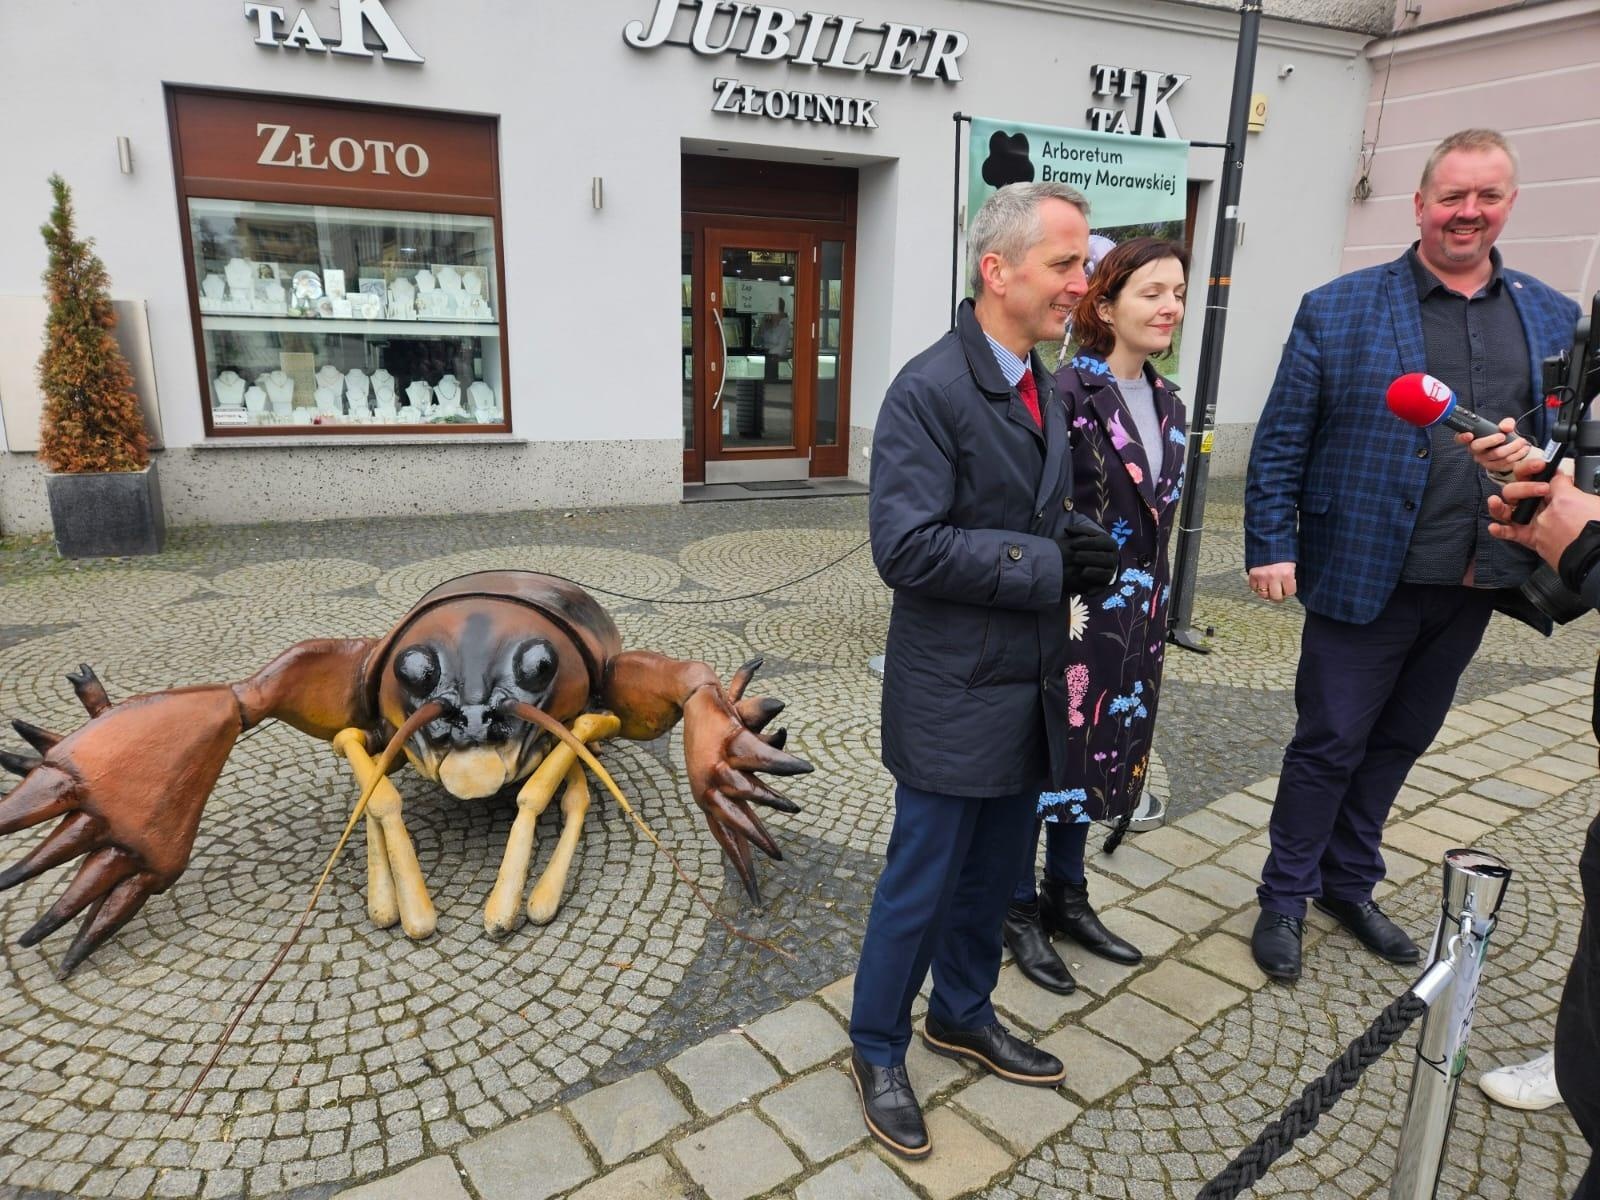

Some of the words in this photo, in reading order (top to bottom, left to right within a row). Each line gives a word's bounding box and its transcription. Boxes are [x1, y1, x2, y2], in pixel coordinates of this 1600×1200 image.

[624, 0, 969, 82] JUBILER
[712, 77, 879, 129] ZŁOTNIK
[256, 122, 430, 178] ZŁOTO
[1041, 141, 1124, 164] Arboretum
[1041, 164, 1092, 190] Bramy
[1095, 170, 1176, 196] Morawskiej
